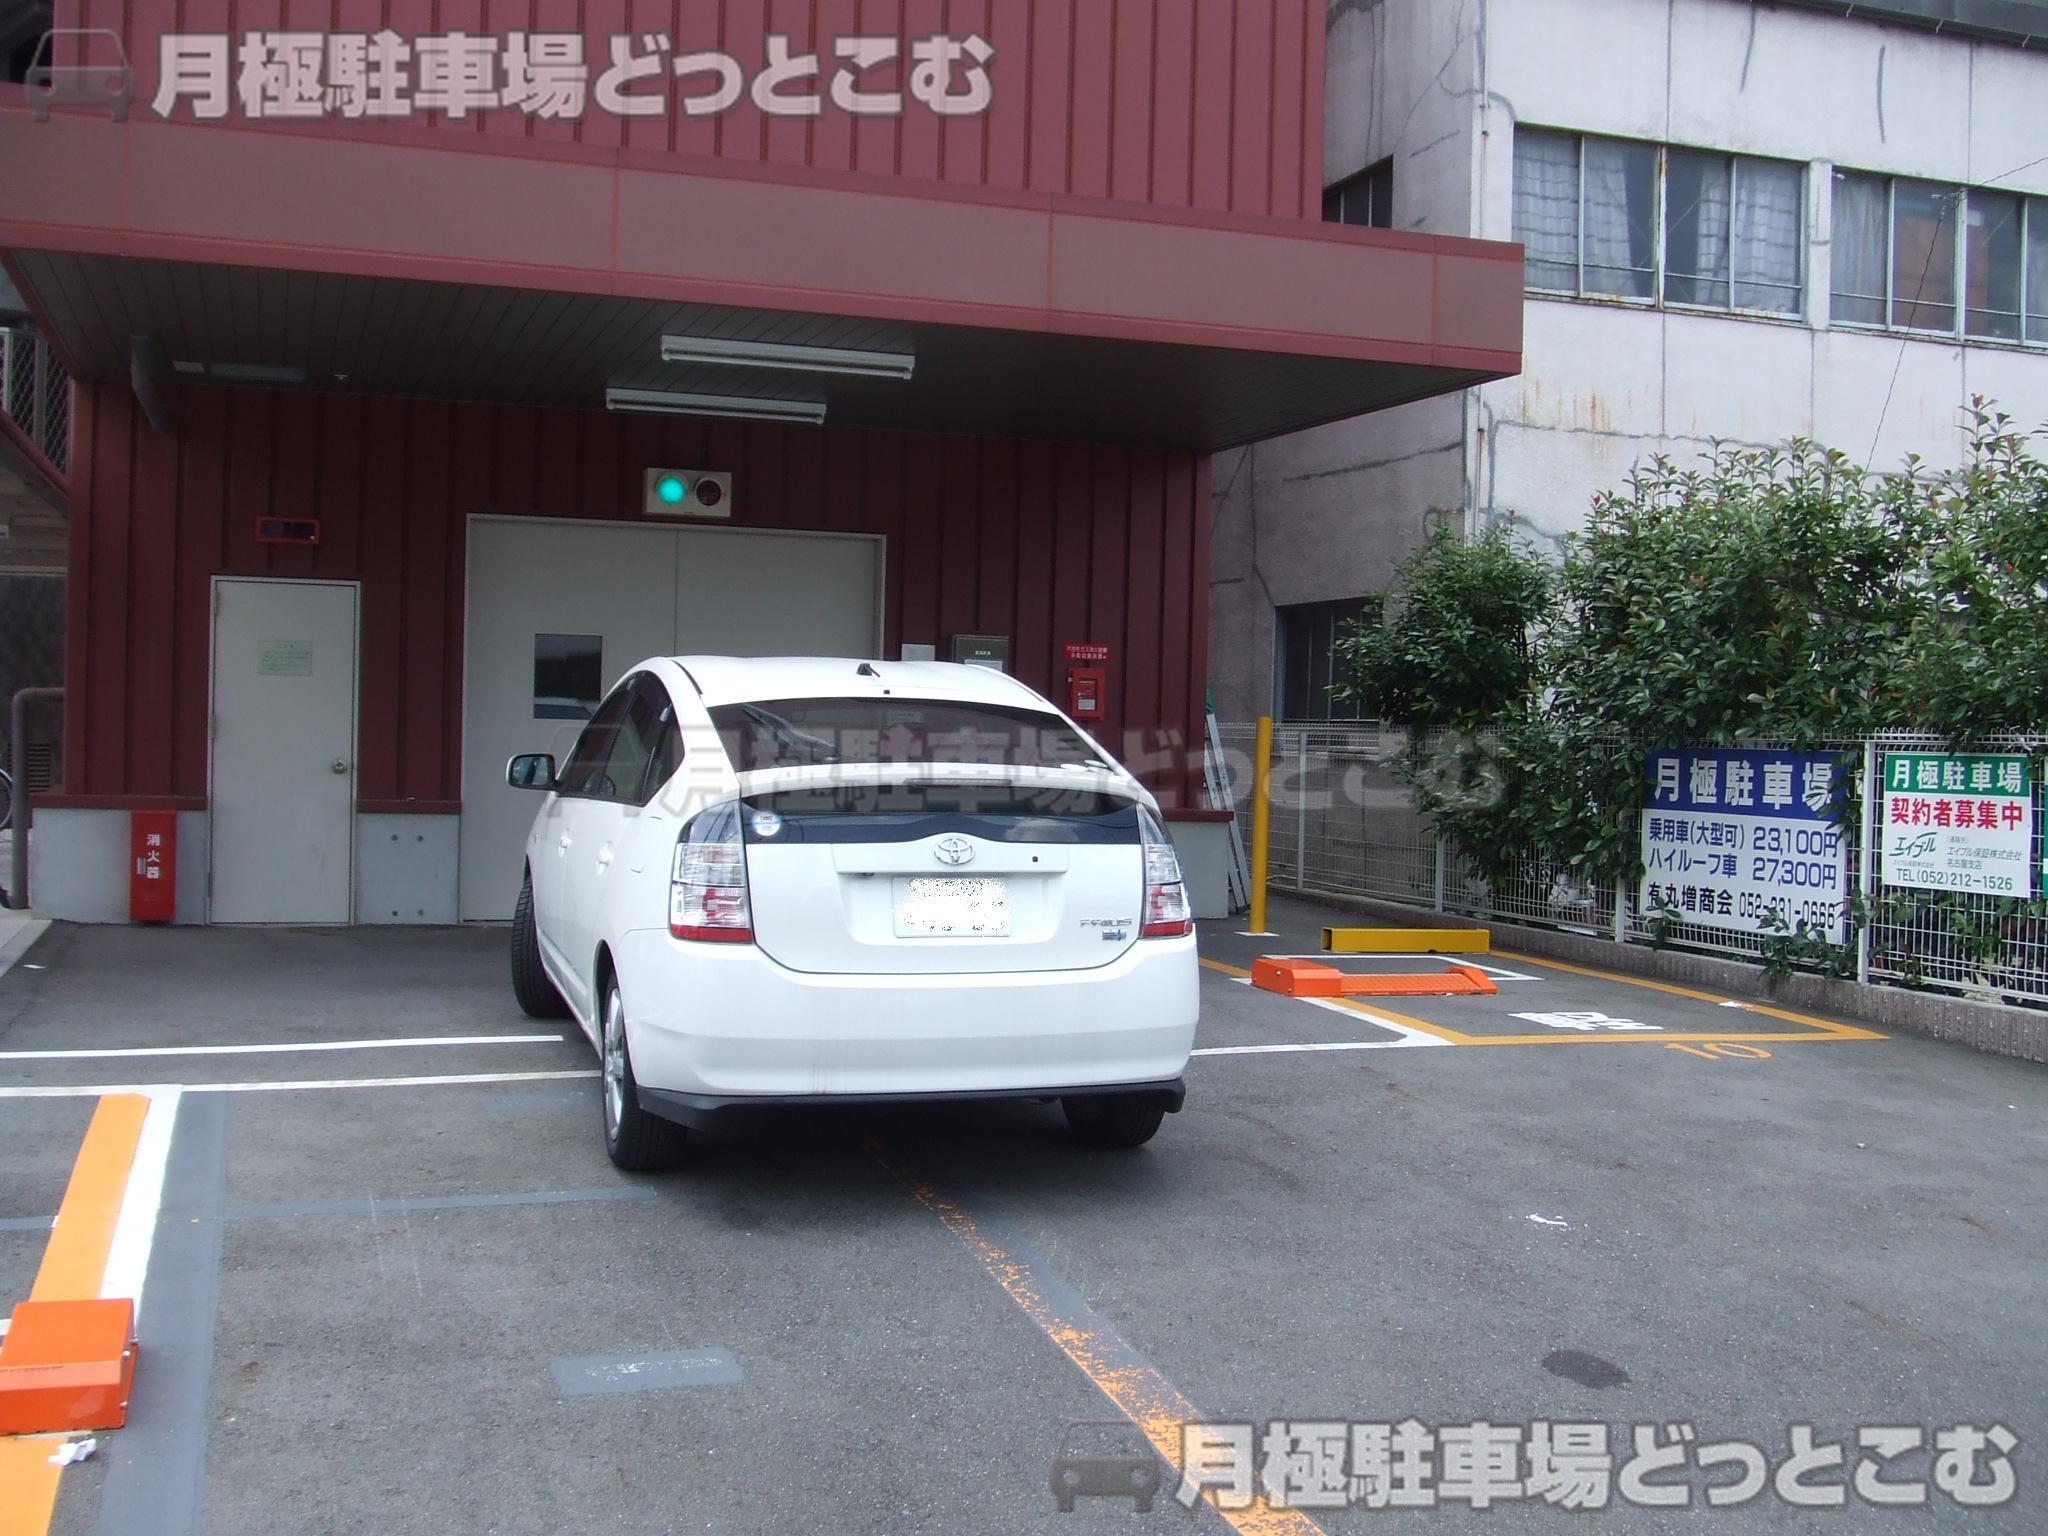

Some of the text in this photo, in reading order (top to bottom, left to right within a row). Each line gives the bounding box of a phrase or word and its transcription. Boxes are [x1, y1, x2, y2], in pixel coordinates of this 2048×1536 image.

[1655, 757, 1833, 811] 月極駐車場
[1892, 759, 2022, 793] 月極駐車場
[1891, 797, 2023, 831] 契約者募集中
[1753, 826, 1838, 858] 23,100円
[1889, 832, 1937, 858] エイブル
[1649, 847, 1836, 890] ハイルーフ車 27,300円
[1664, 1042, 1773, 1060] 10
